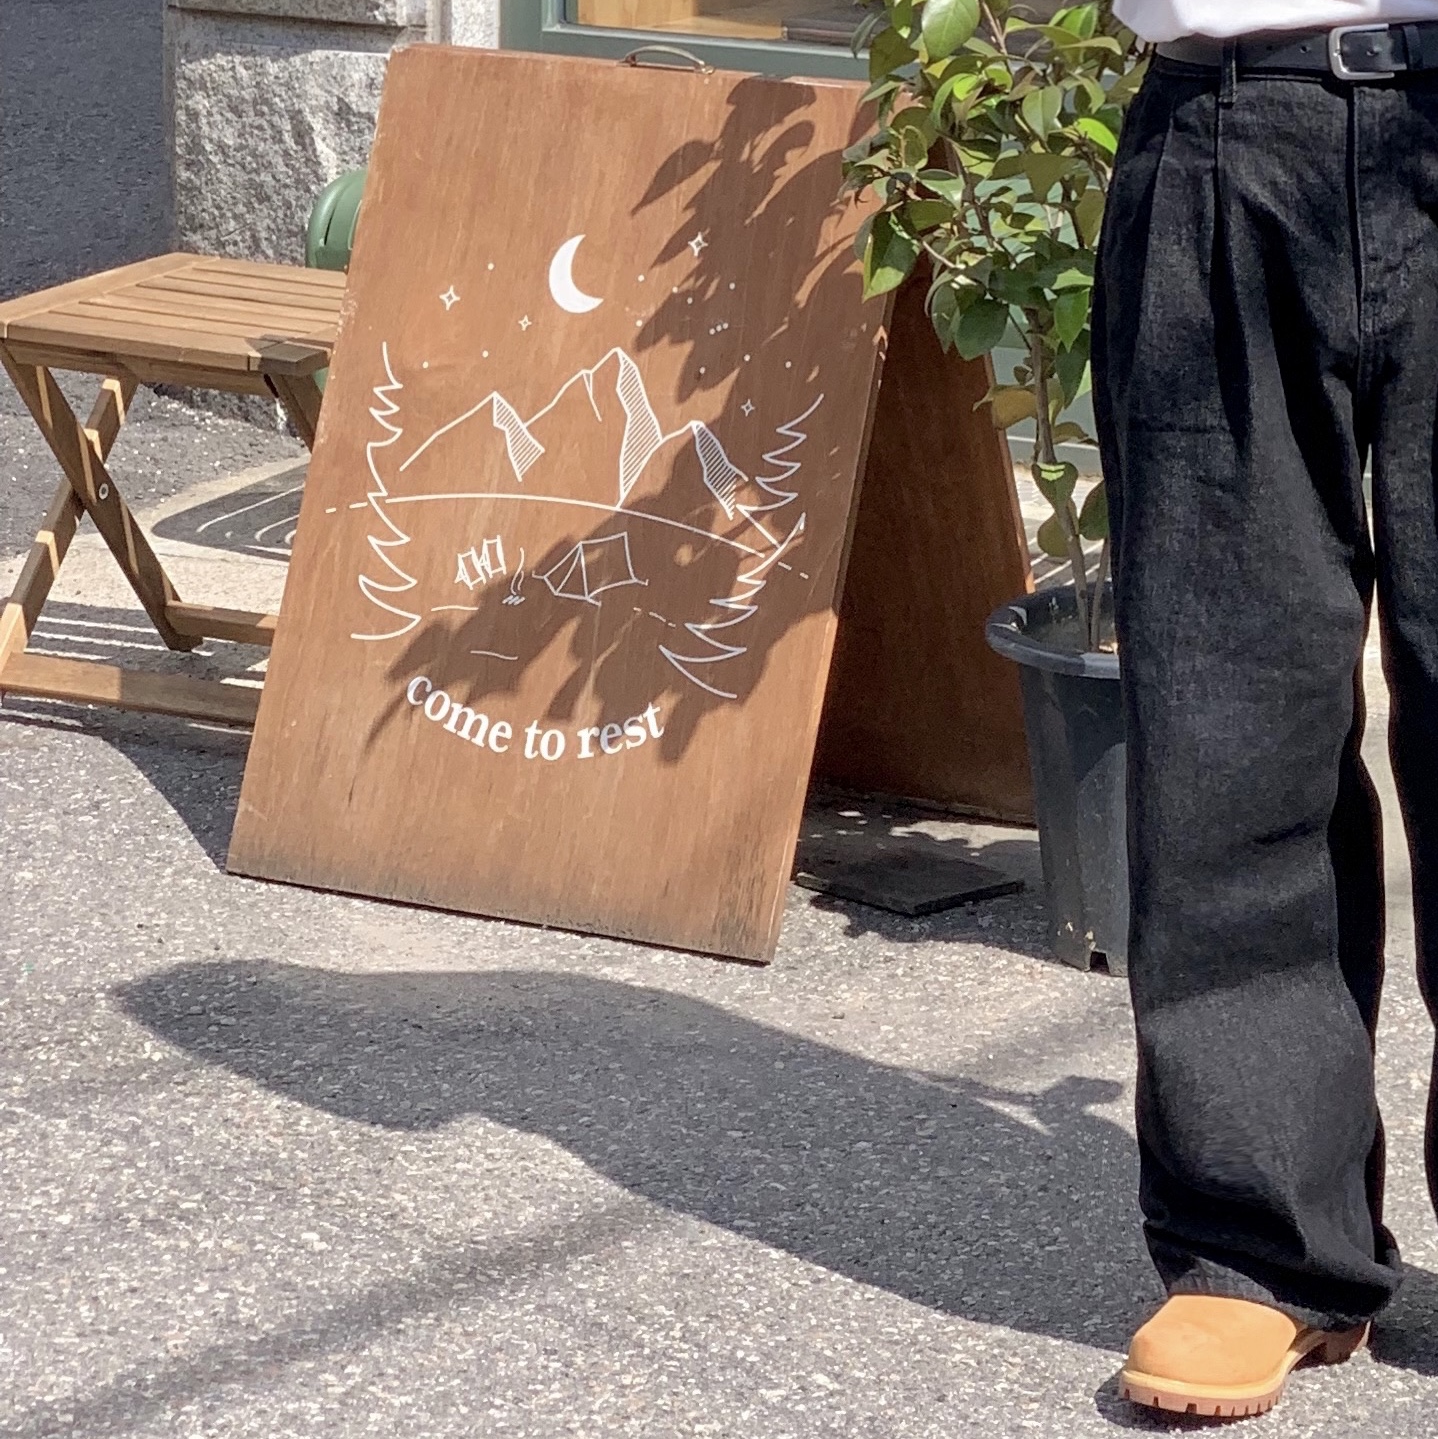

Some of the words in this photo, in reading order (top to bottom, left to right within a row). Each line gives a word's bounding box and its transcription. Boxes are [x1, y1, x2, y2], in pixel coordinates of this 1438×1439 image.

[406, 675, 512, 753] come
[524, 719, 566, 761] to
[577, 702, 665, 759] rest
